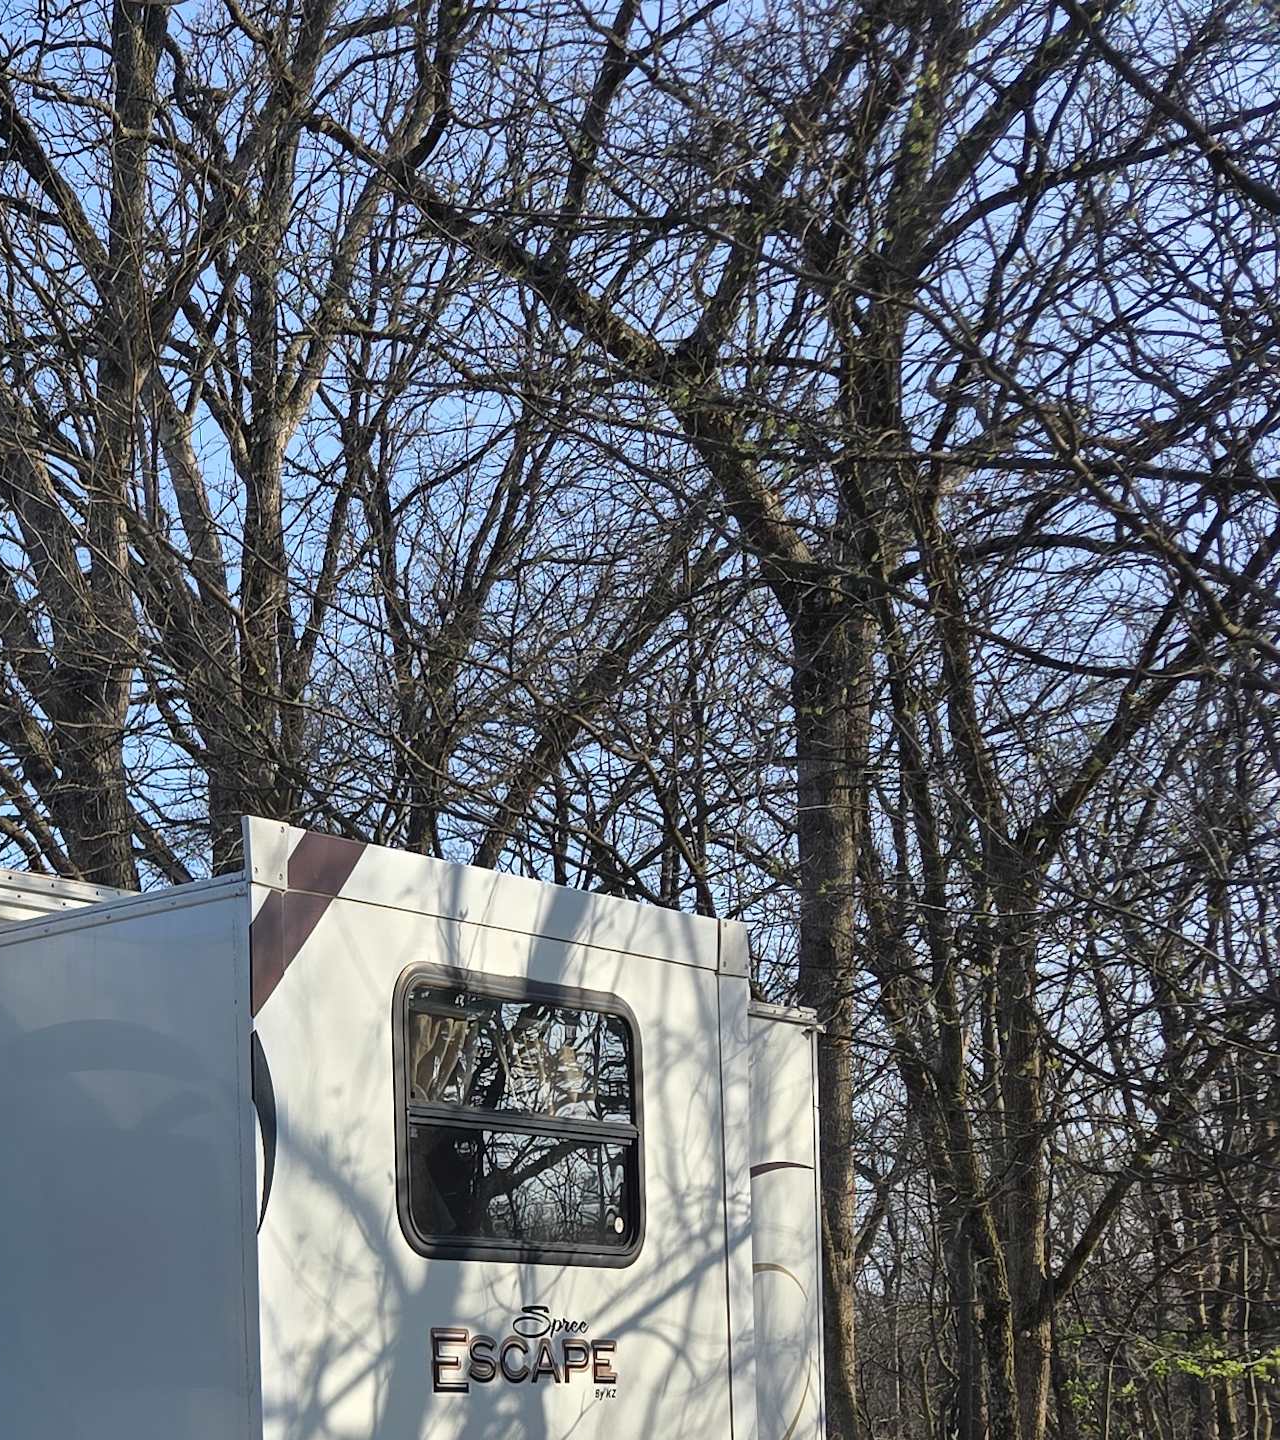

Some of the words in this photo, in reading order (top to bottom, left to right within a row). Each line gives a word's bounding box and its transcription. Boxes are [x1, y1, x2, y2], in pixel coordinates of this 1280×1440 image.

[512, 1306, 589, 1338] Spree
[430, 1328, 617, 1393] ESCAPE
[606, 1388, 617, 1399] KZ
